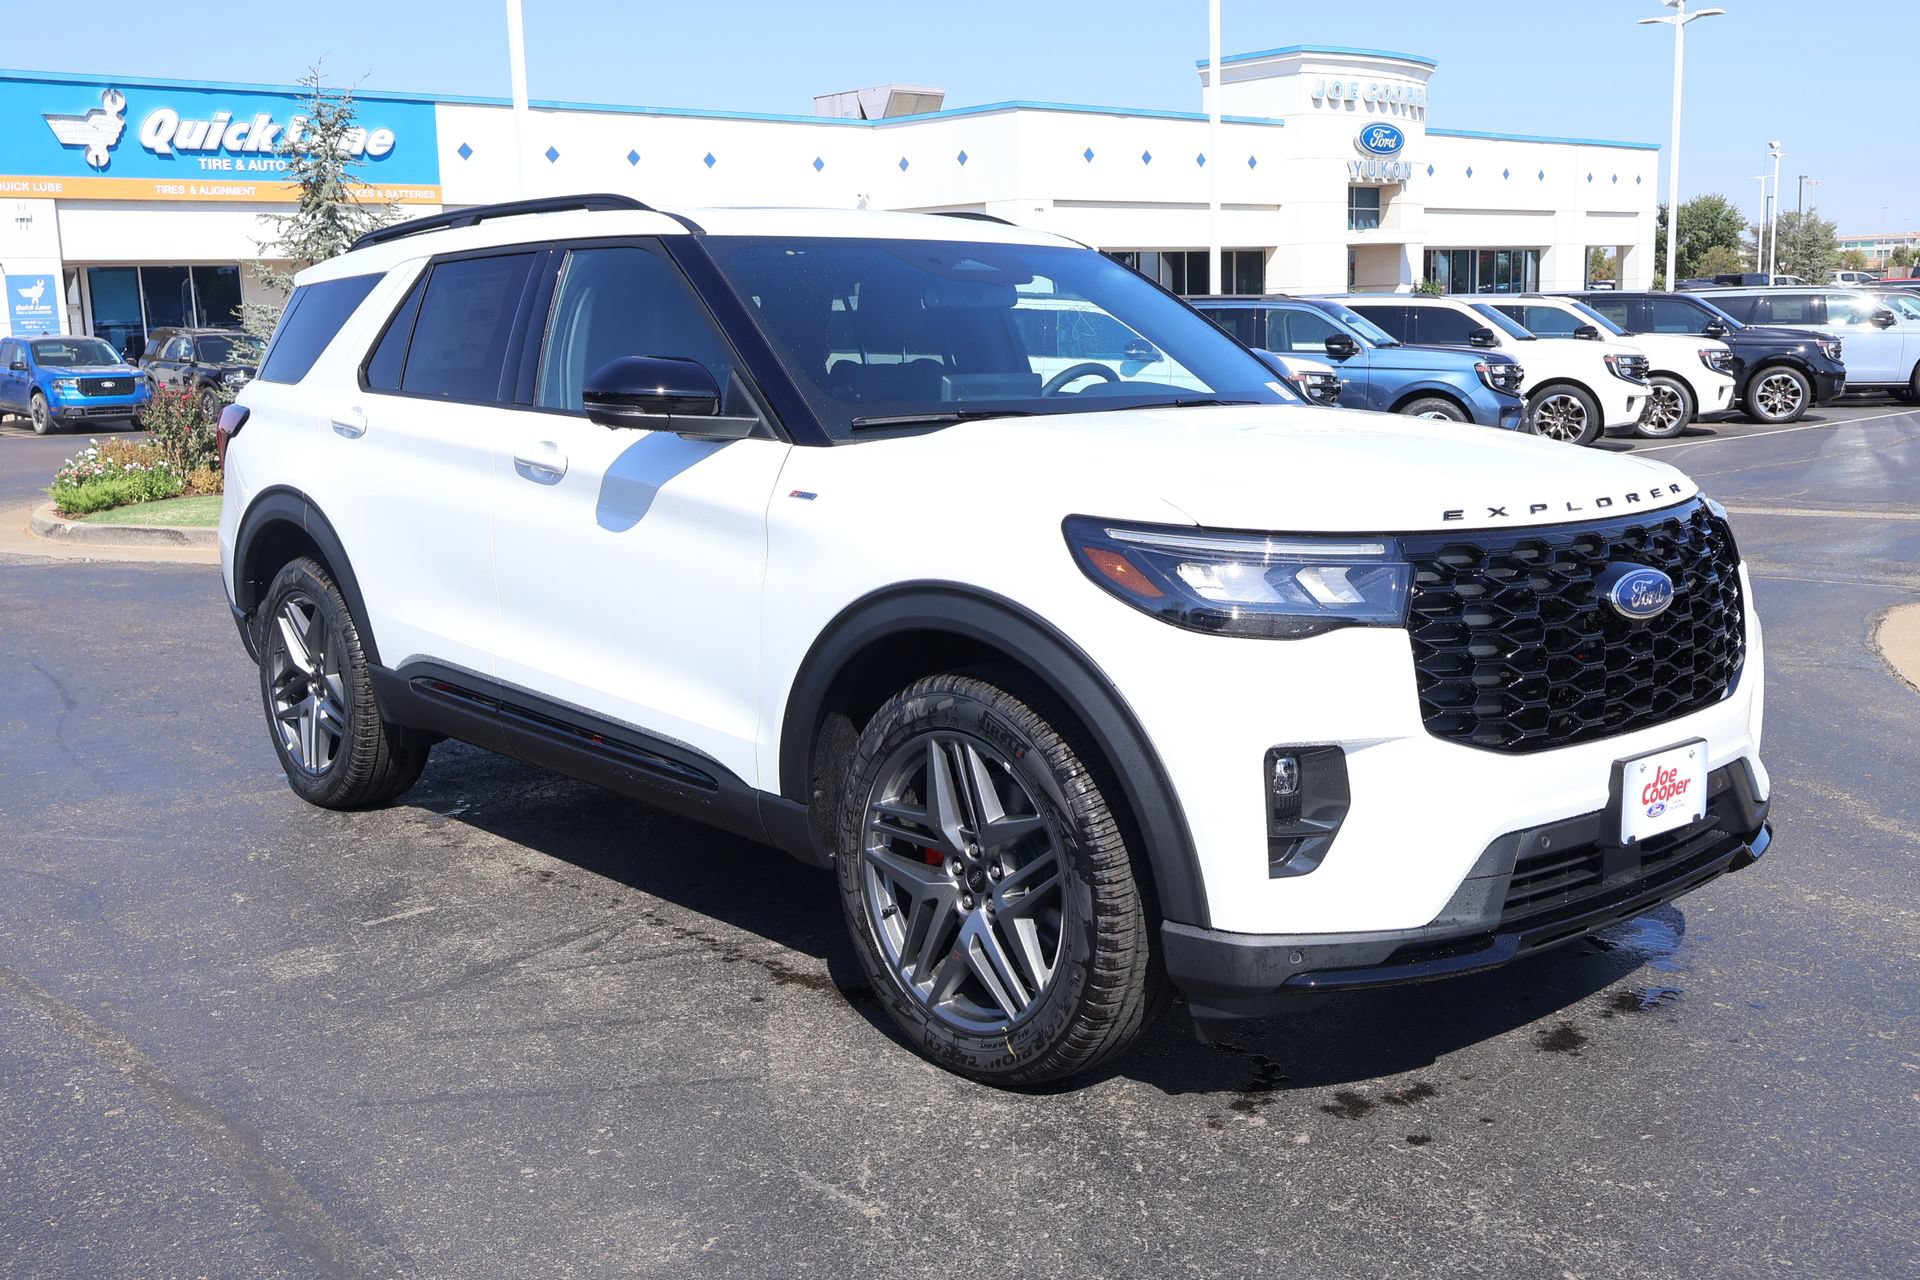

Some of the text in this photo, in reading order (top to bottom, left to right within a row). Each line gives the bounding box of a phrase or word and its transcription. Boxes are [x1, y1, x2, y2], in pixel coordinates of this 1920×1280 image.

[1314, 79, 1360, 102] JOE
[139, 107, 283, 154] Quick
[1370, 128, 1398, 148] Ford
[197, 158, 232, 171] TIRE
[235, 159, 246, 171] &
[247, 159, 287, 172] AUTO
[1352, 160, 1412, 180] YUKON
[0, 181, 64, 192] UICK LUBE
[155, 184, 256, 196] TIRES & ALIGNMENT
[385, 190, 436, 199] BATTERIES
[1442, 483, 1682, 522] EXPLORER
[1631, 579, 1665, 608] Ford
[1651, 765, 1678, 788] Joe
[1641, 777, 1691, 806] Cooper
